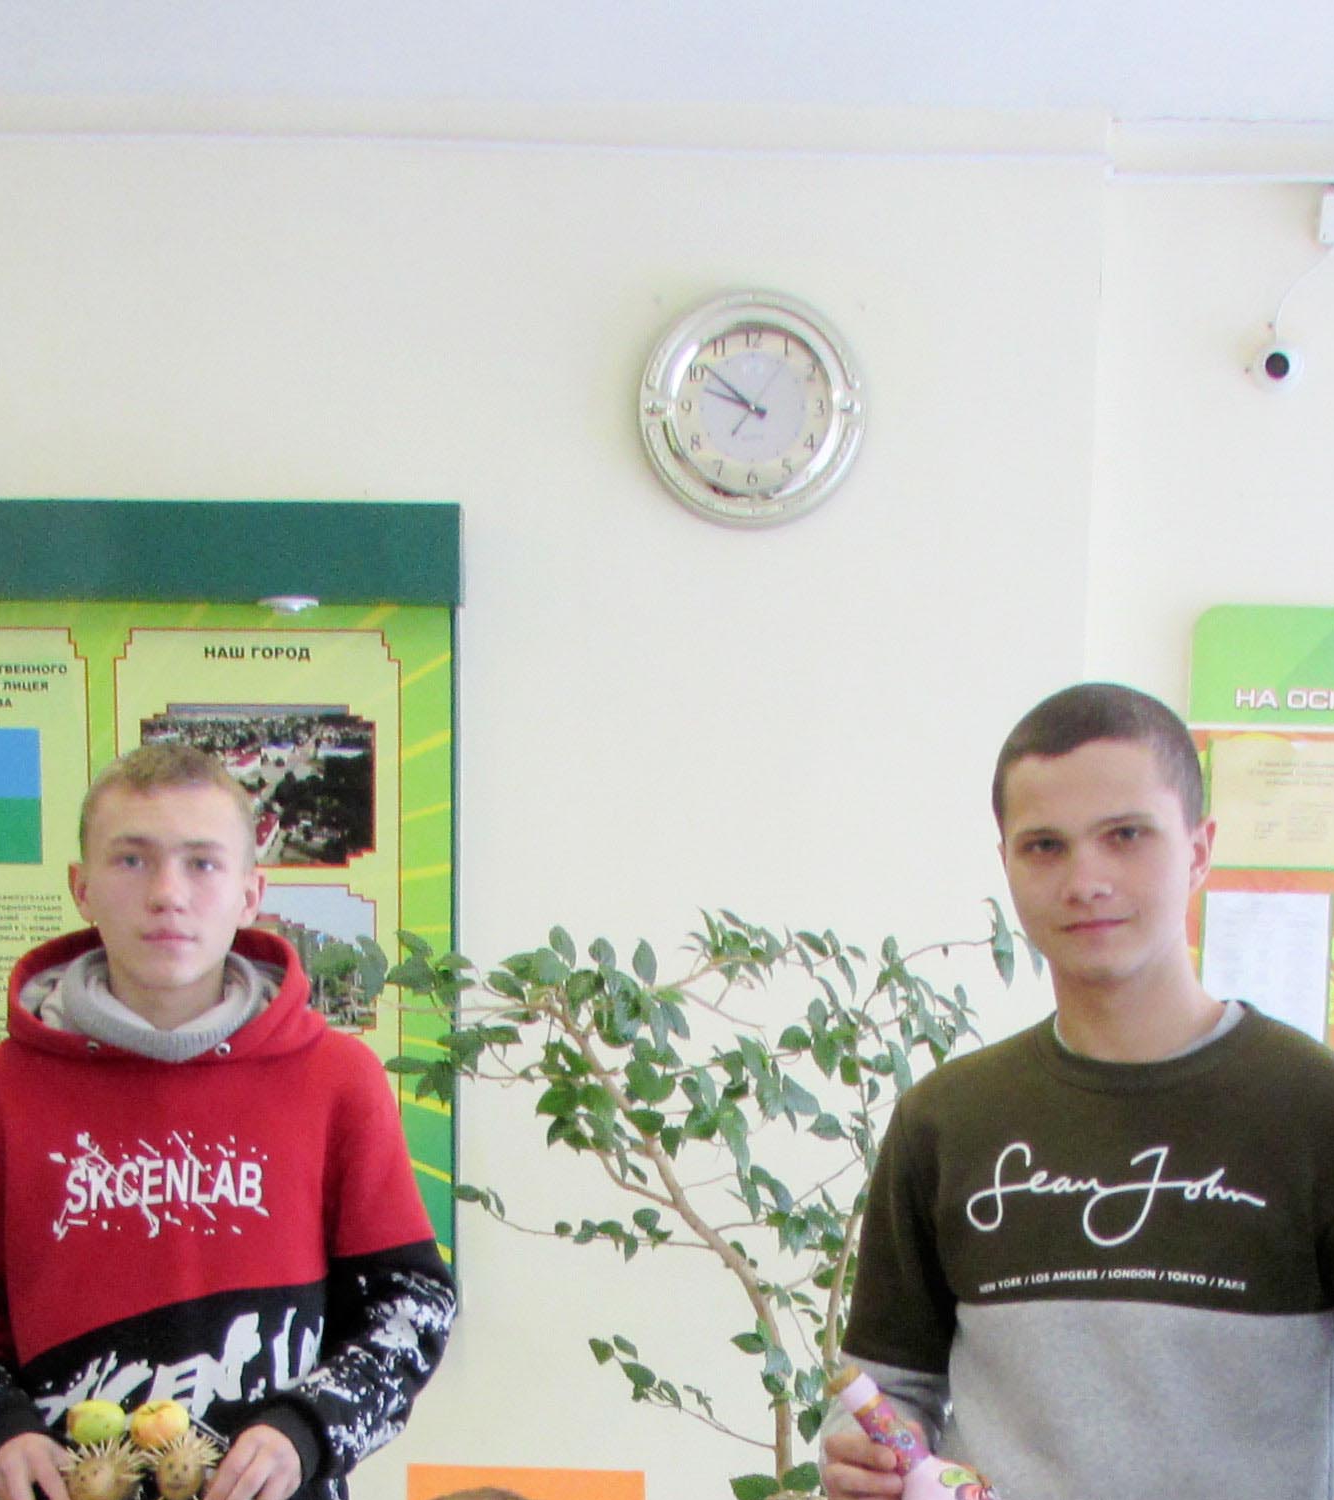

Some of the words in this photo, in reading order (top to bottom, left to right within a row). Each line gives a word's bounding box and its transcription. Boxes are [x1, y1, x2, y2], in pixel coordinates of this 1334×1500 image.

[745, 329, 762, 348] 12
[713, 338, 725, 356] 11
[689, 363, 704, 382] 10
[681, 400, 692, 415] 9
[815, 400, 825, 416] 3
[690, 435, 700, 450] 8
[804, 434, 814, 449] 4
[714, 460, 723, 476] 7
[782, 459, 793, 474] 5
[747, 472, 758, 485] 6
[204, 646, 245, 659] НАШ
[251, 646, 311, 662] ГОРОД
[3, 681, 49, 693] ЛИЦЕЯ
[1235, 687, 1278, 710] НА
[967, 1142, 1103, 1232] Sean
[1083, 1146, 1266, 1247] John
[998, 1276, 1022, 1289] YORK
[1031, 1272, 1050, 1285] LOS
[1052, 1269, 1098, 1281] ANGELES
[1108, 1269, 1156, 1280] LONDON
[1167, 1271, 1207, 1285] TOKYO
